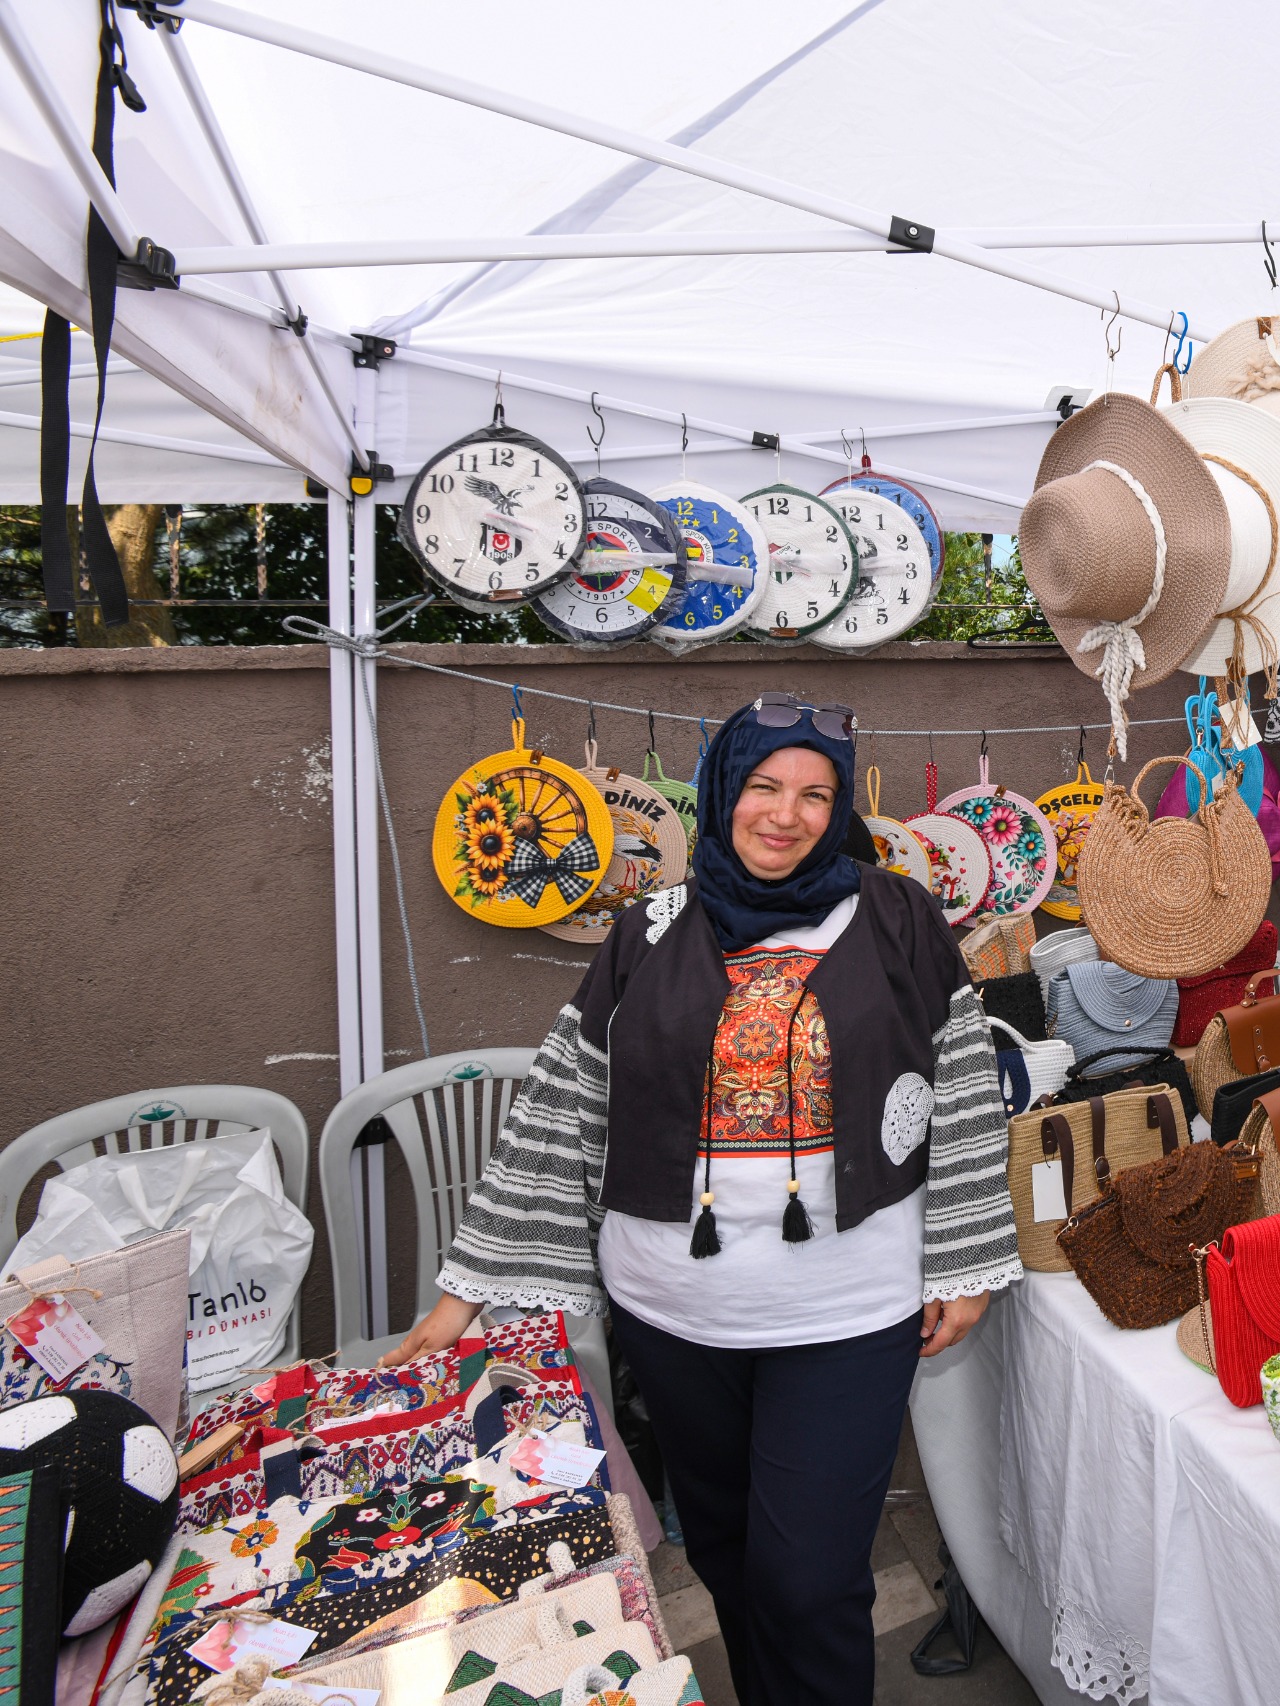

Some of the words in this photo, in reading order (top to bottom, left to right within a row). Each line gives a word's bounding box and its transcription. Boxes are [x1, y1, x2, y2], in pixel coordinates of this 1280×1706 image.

[456, 453, 481, 473] 11
[489, 447, 515, 468] 12
[531, 459, 542, 477] 1
[429, 474, 454, 494] 10
[555, 482, 569, 501] 2
[416, 504, 431, 524] 9
[588, 502, 608, 518] 12
[677, 501, 694, 515] 12
[767, 497, 790, 516] 12
[804, 505, 815, 522] 1
[839, 505, 861, 523] 12
[564, 514, 578, 533] 3
[712, 510, 718, 524] 1
[876, 513, 886, 530] 1
[914, 513, 925, 530] 2
[597, 523, 628, 540] SPOR
[645, 528, 652, 538] 2
[728, 528, 738, 543] 2
[826, 526, 838, 543] 2
[425, 535, 439, 554] 8
[553, 540, 567, 560] 4
[897, 534, 909, 551] 2
[453, 558, 466, 578] 7
[740, 555, 749, 569] 3
[905, 562, 917, 579] 3
[488, 571, 503, 590] 6
[526, 562, 540, 582] 5
[586, 592, 615, 600] 1907
[648, 585, 656, 595] 4
[828, 579, 841, 597] 4
[898, 587, 910, 604] 4
[568, 606, 576, 616] 7
[596, 608, 608, 623] 6
[628, 606, 635, 615] 5
[713, 605, 723, 619] 5
[807, 601, 819, 619] 5
[876, 608, 888, 625] 5
[685, 612, 695, 626] 6
[776, 611, 788, 628] 6
[845, 616, 857, 633] 6
[208, 1307, 271, 1336] DÜNYASI
